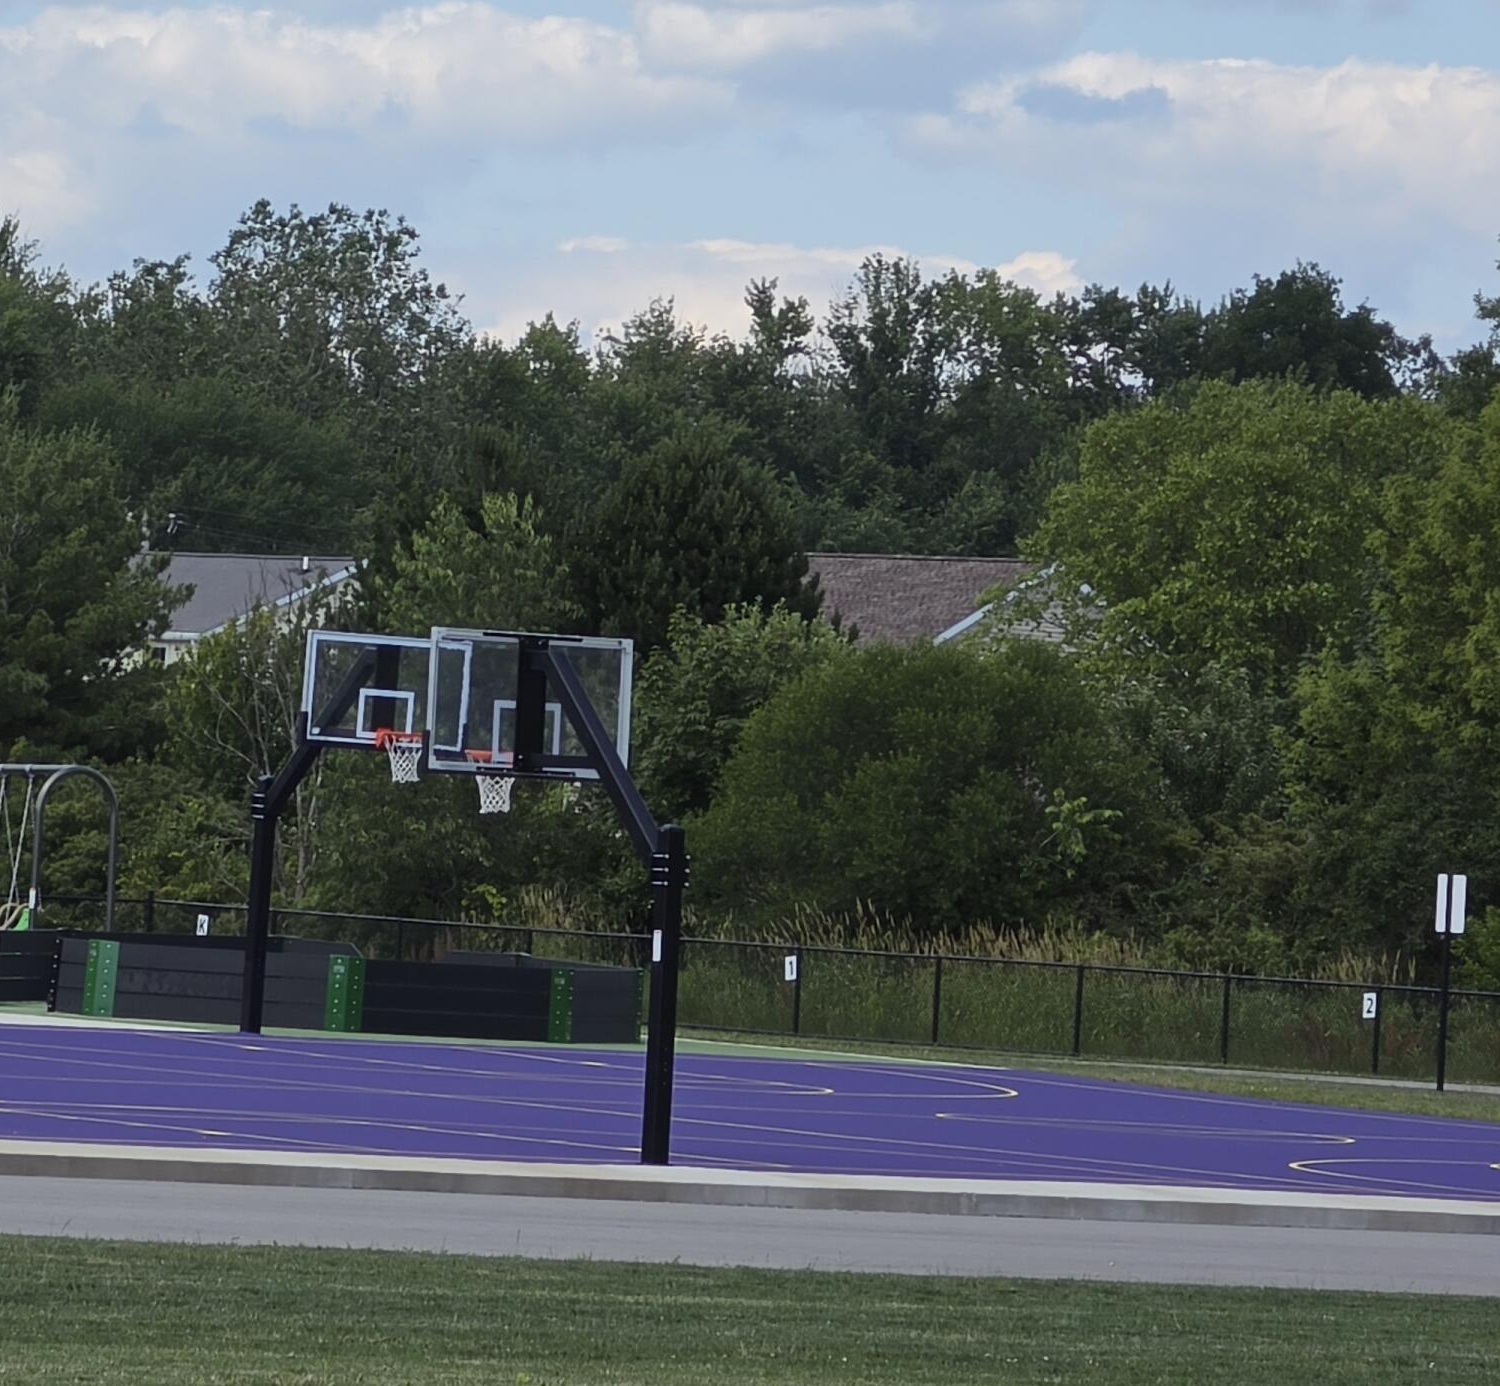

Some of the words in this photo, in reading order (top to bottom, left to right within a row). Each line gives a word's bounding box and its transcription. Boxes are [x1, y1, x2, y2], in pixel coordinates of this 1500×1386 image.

[199, 919, 206, 934] K
[789, 960, 794, 976] 1
[1366, 997, 1374, 1014] 2
